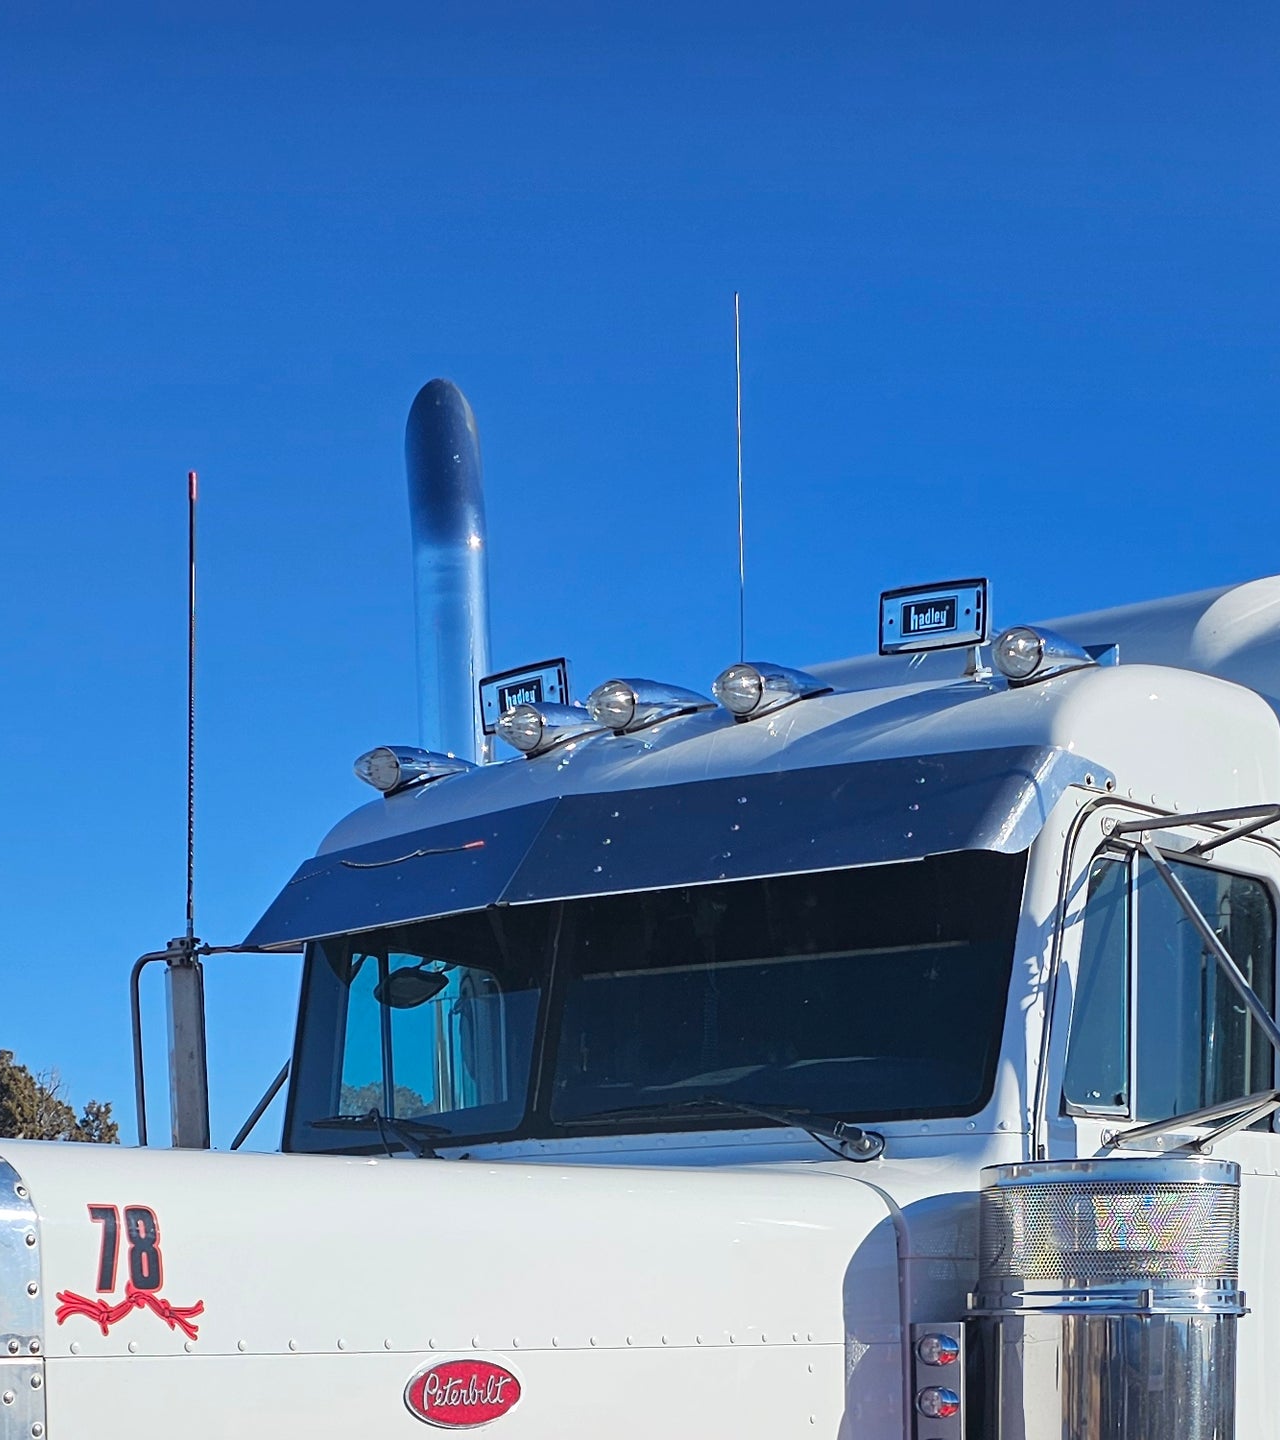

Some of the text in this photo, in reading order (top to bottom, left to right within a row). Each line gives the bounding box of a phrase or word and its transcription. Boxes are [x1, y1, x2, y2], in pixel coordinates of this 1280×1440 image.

[910, 605, 947, 631] hadley
[504, 687, 536, 711] hadley
[87, 1204, 163, 1293] 78
[423, 1373, 511, 1411] Peterbilt
